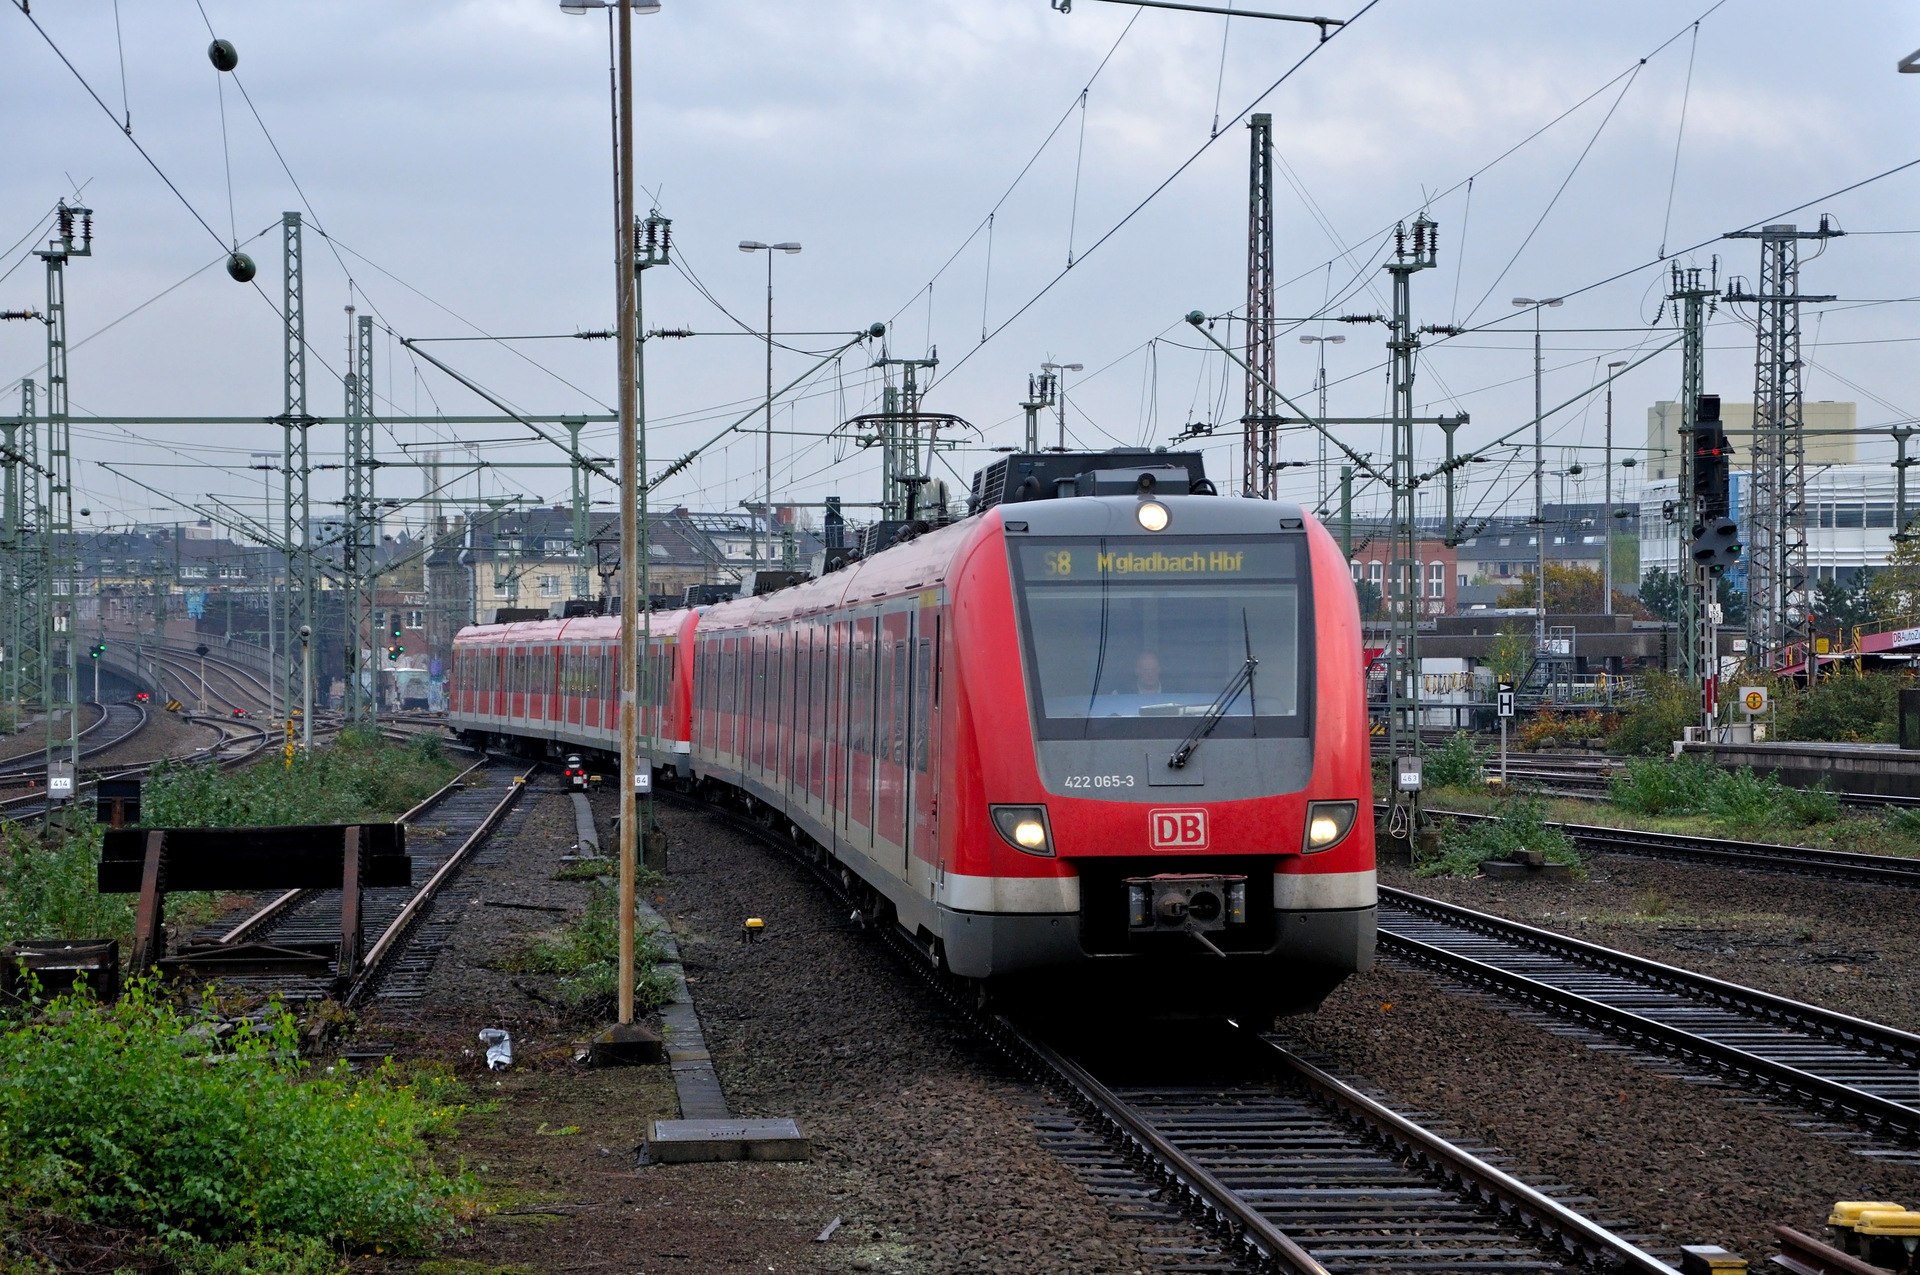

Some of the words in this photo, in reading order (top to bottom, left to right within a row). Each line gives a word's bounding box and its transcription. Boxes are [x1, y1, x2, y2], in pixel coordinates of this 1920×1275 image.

[1044, 551, 1071, 575] S8
[1097, 552, 1205, 573] M'gladbach
[1210, 551, 1243, 571] Hbf
[1894, 629, 1920, 643] DBAutoZ
[1500, 695, 1512, 714] H
[1064, 776, 1091, 788] 422
[1094, 775, 1135, 788] 065-3
[1157, 815, 1201, 843] DB
